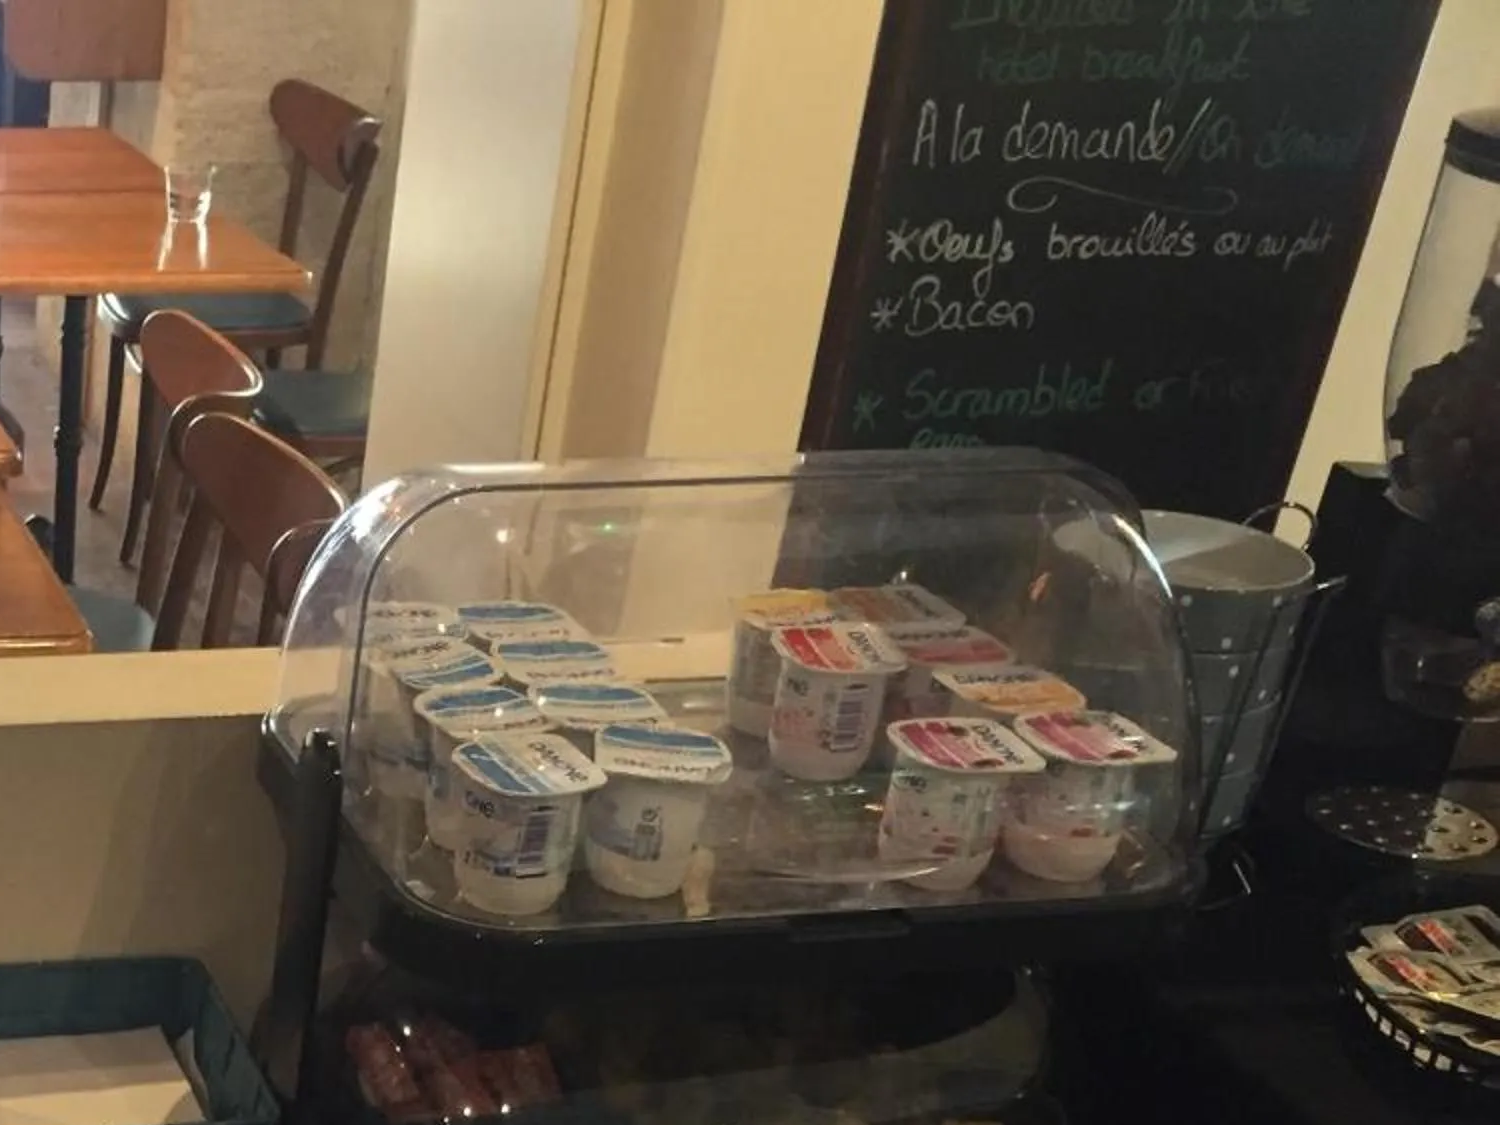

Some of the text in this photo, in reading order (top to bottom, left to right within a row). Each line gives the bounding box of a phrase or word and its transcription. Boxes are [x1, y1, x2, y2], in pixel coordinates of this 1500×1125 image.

[950, 104, 981, 162] la
[904, 274, 1035, 337] Bacon
[904, 360, 1111, 419] Scrambled
